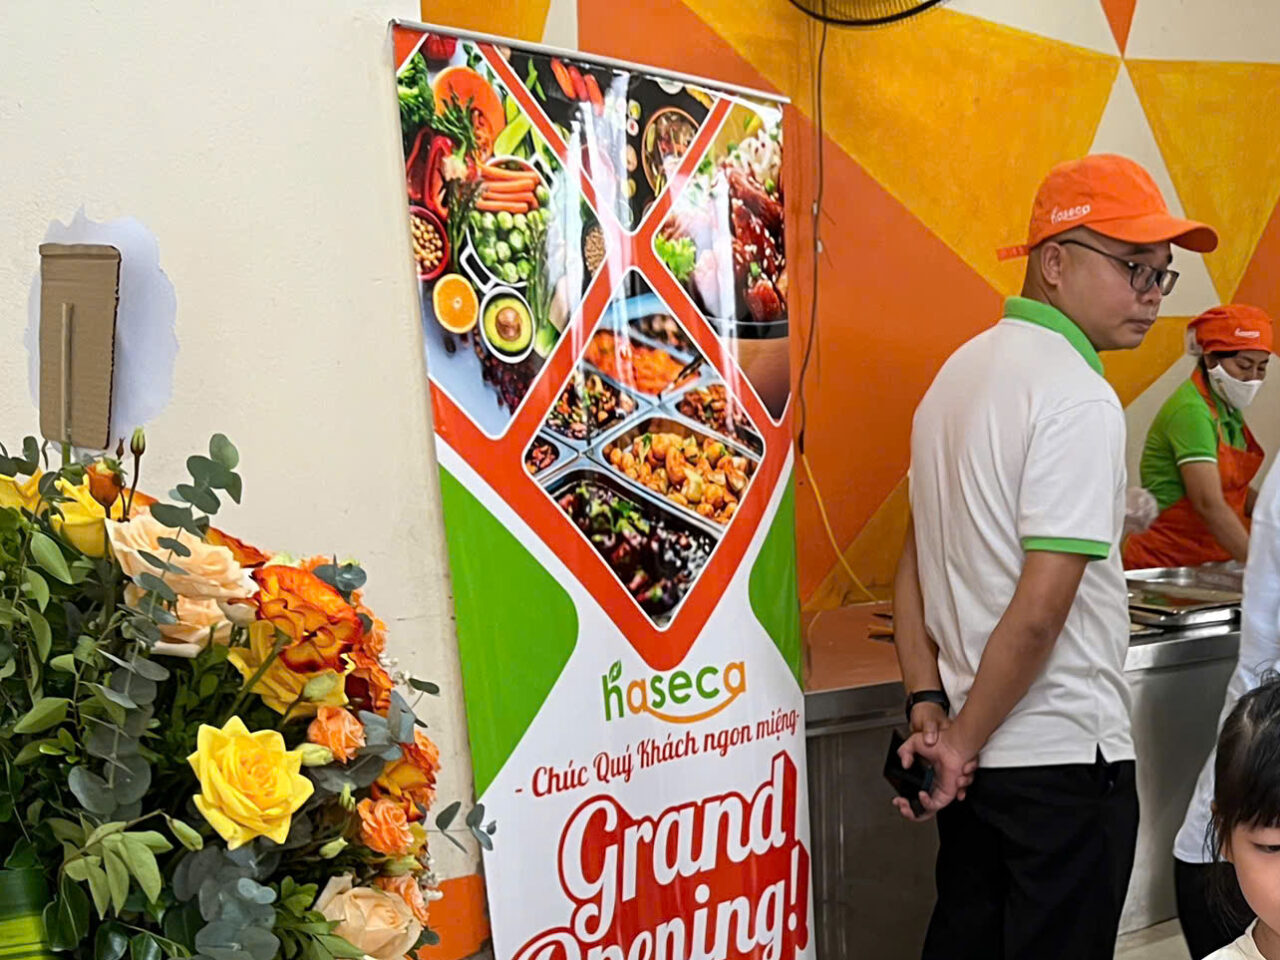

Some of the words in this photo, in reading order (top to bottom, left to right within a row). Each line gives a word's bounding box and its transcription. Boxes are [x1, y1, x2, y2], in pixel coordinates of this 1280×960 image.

[602, 660, 746, 724] haseca
[531, 760, 590, 798] Chúc
[593, 744, 633, 783] Quý
[636, 730, 699, 769] Khách
[703, 723, 752, 758] ngon
[558, 750, 797, 944] Grand
